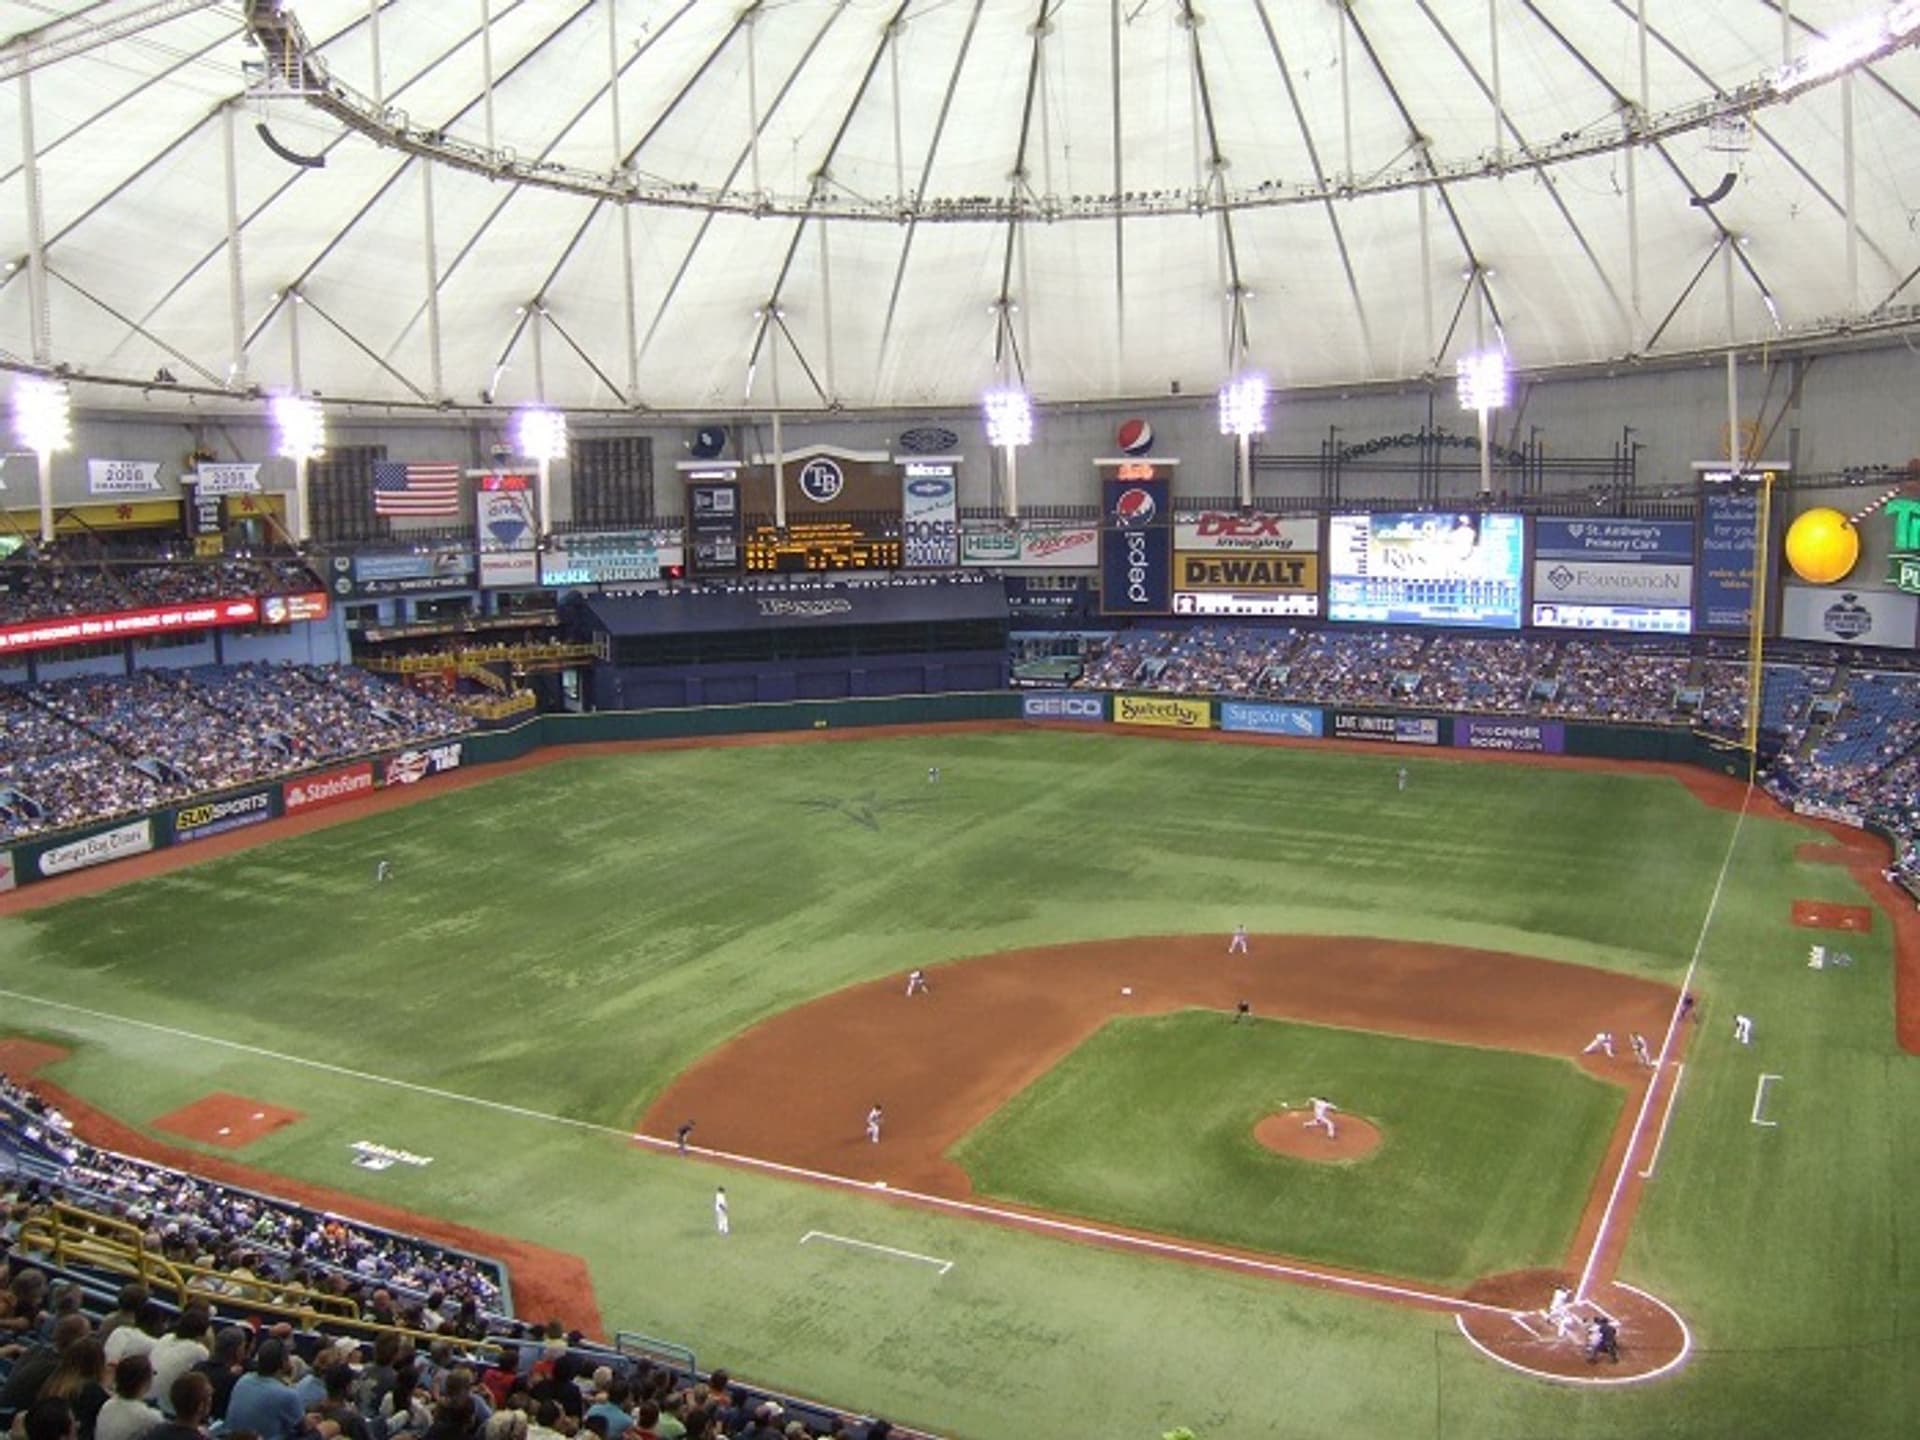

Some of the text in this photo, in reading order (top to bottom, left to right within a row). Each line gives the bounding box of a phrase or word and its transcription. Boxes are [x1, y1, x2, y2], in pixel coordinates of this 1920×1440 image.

[810, 467, 835, 493] TB
[1196, 513, 1282, 537] DEX
[968, 537, 1015, 550] HESS
[1585, 537, 1658, 550] Primary Care
[1124, 531, 1149, 603] pepsi
[1024, 698, 1100, 715] GEICO
